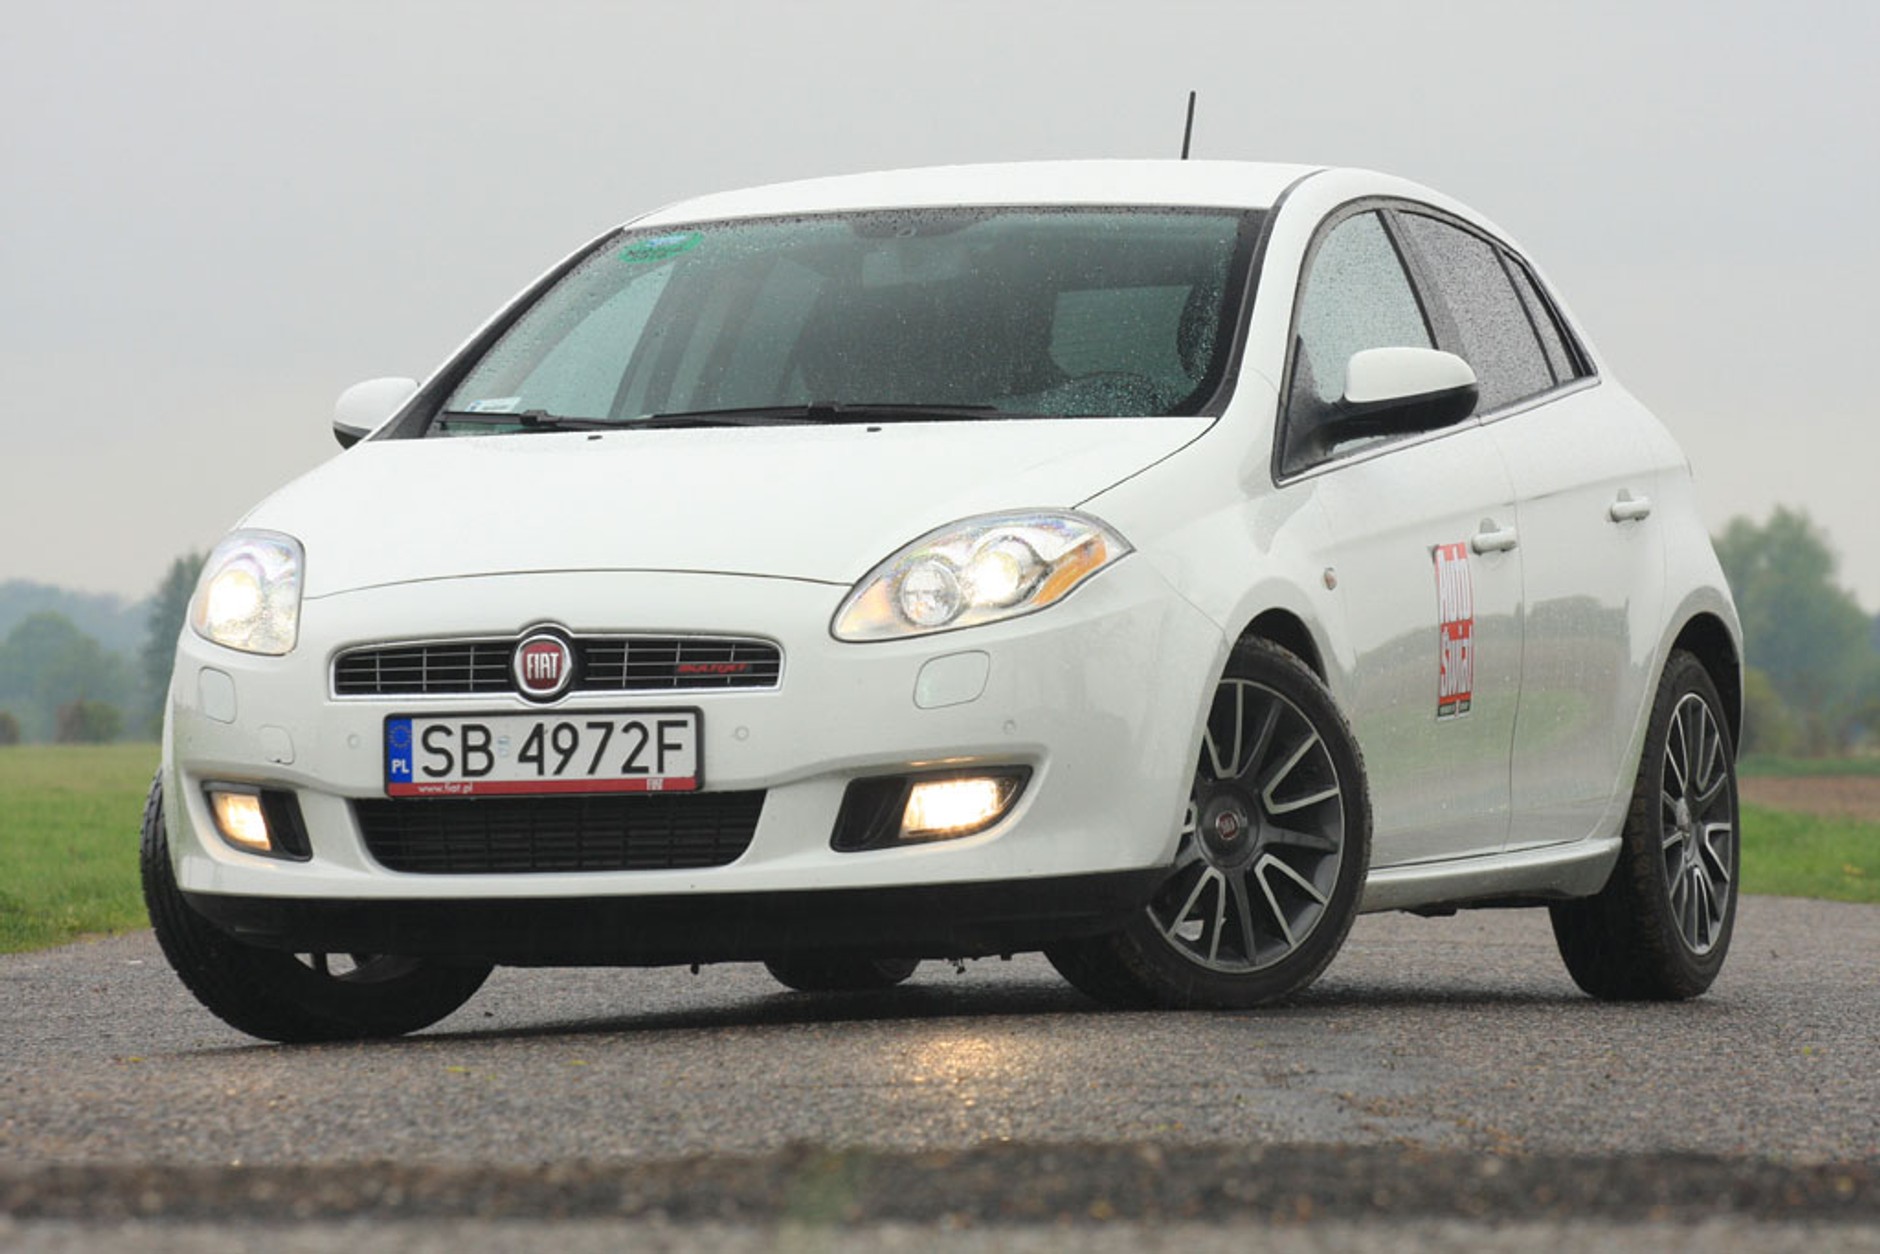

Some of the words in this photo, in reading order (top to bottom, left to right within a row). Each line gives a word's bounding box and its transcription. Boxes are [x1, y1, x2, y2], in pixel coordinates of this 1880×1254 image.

[526, 652, 559, 679] FIAT
[421, 723, 495, 778] SB
[518, 719, 688, 776] 4972F
[391, 759, 410, 774] PL
